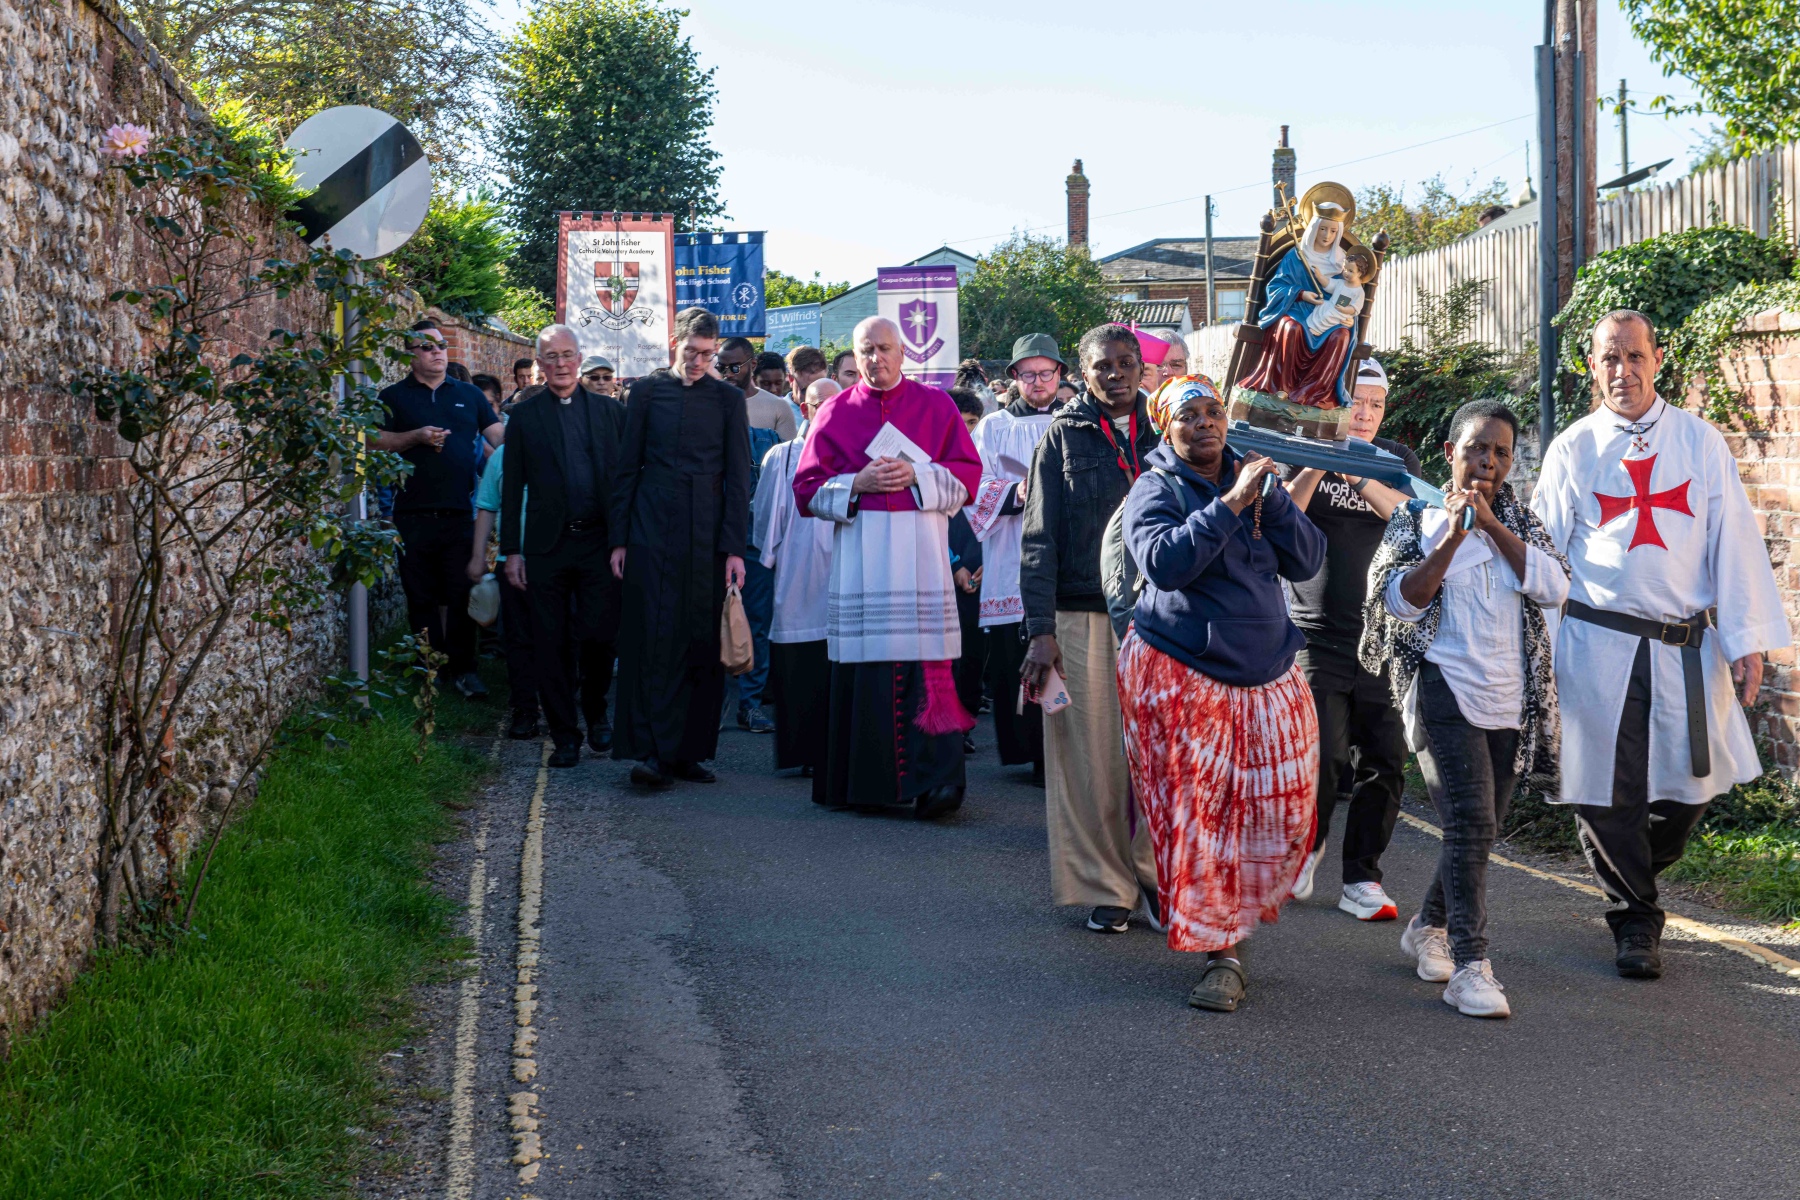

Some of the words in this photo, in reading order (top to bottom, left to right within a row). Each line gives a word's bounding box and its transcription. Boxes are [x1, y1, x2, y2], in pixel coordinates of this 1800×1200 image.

[592, 238, 600, 246] St
[601, 238, 619, 246] John
[621, 238, 640, 246] Fisher
[675, 265, 695, 276] ohn
[698, 264, 731, 275] Fisher
[689, 278, 706, 287] High
[707, 277, 731, 285] School
[676, 297, 707, 306] arrogate,
[708, 296, 720, 304] UK
[781, 309, 817, 323] Wilfrid's
[1330, 494, 1366, 511] FACE
